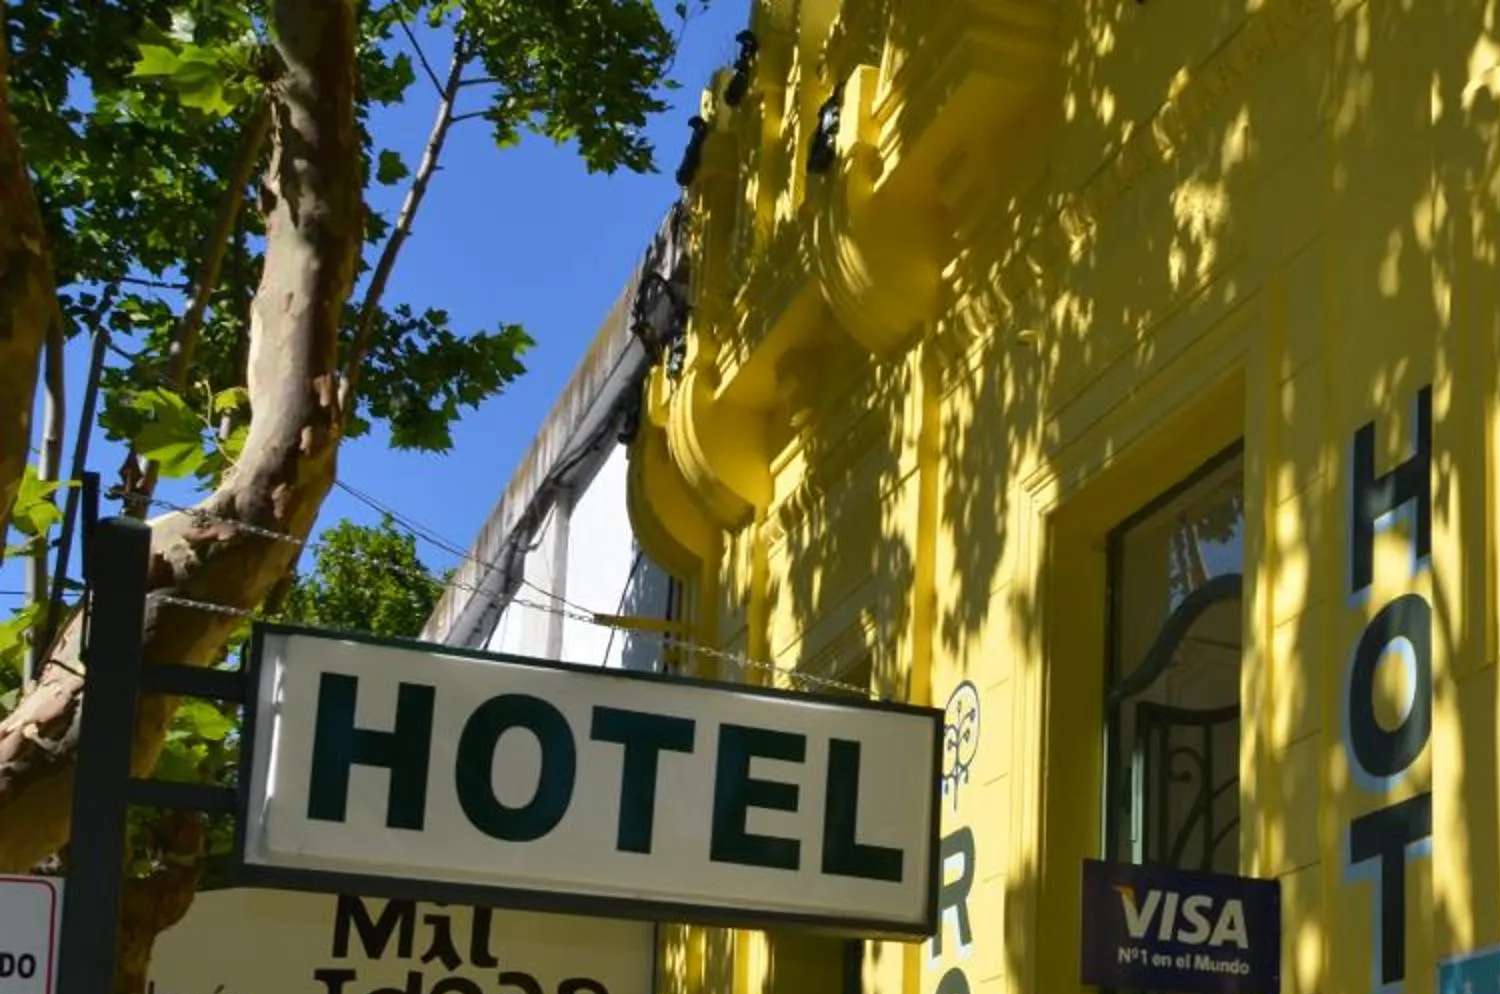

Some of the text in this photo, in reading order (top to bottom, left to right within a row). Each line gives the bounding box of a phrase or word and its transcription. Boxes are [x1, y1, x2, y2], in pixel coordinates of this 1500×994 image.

[306, 671, 905, 883] HOTEL
[332, 892, 498, 972] Mil
[1114, 882, 1249, 949] VISA
[1152, 954, 1172, 968] en
[1176, 952, 1191, 970] el
[1194, 953, 1251, 975] Mundo
